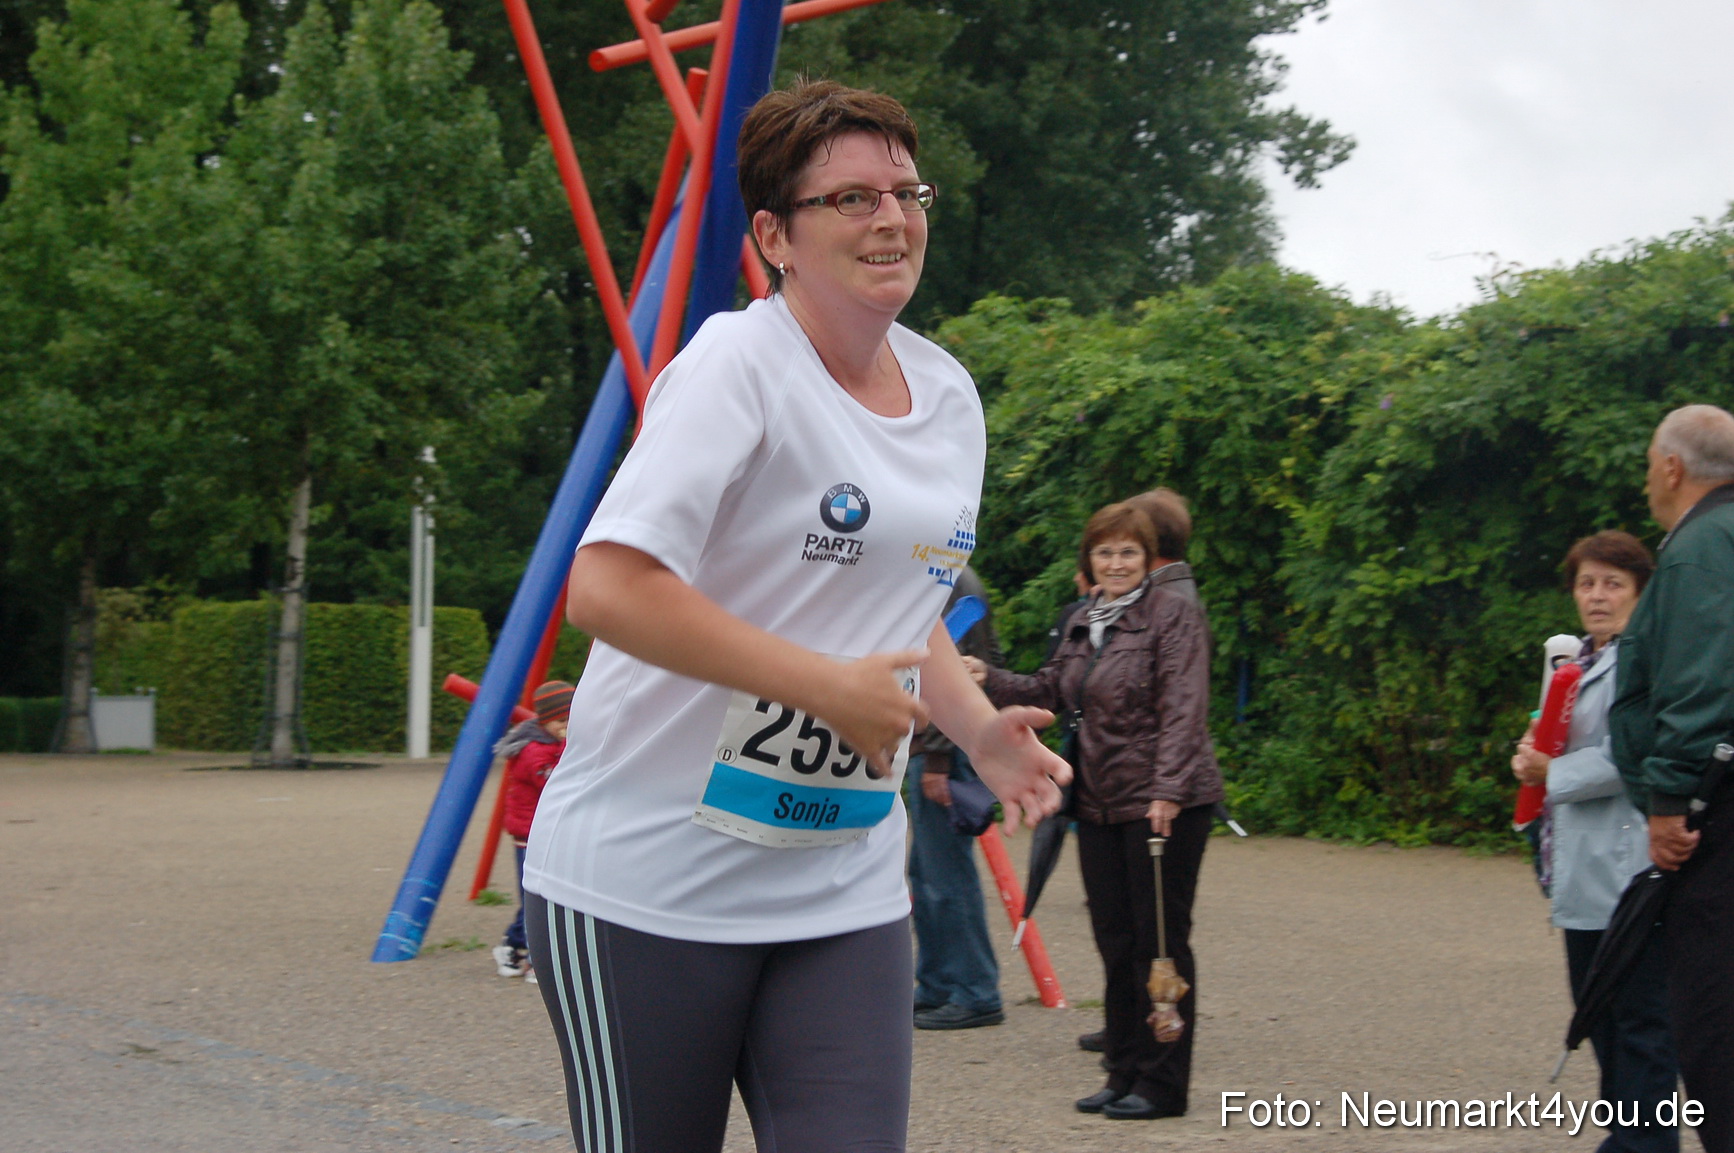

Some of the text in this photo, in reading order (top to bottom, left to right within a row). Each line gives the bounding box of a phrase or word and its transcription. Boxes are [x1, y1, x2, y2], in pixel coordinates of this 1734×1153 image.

[827, 484, 867, 504] BMW
[805, 533, 864, 556] PARTL
[911, 544, 930, 562] 14.
[801, 549, 859, 566] Neumarkt
[740, 698, 895, 781] 259
[773, 793, 840, 828] Sonja
